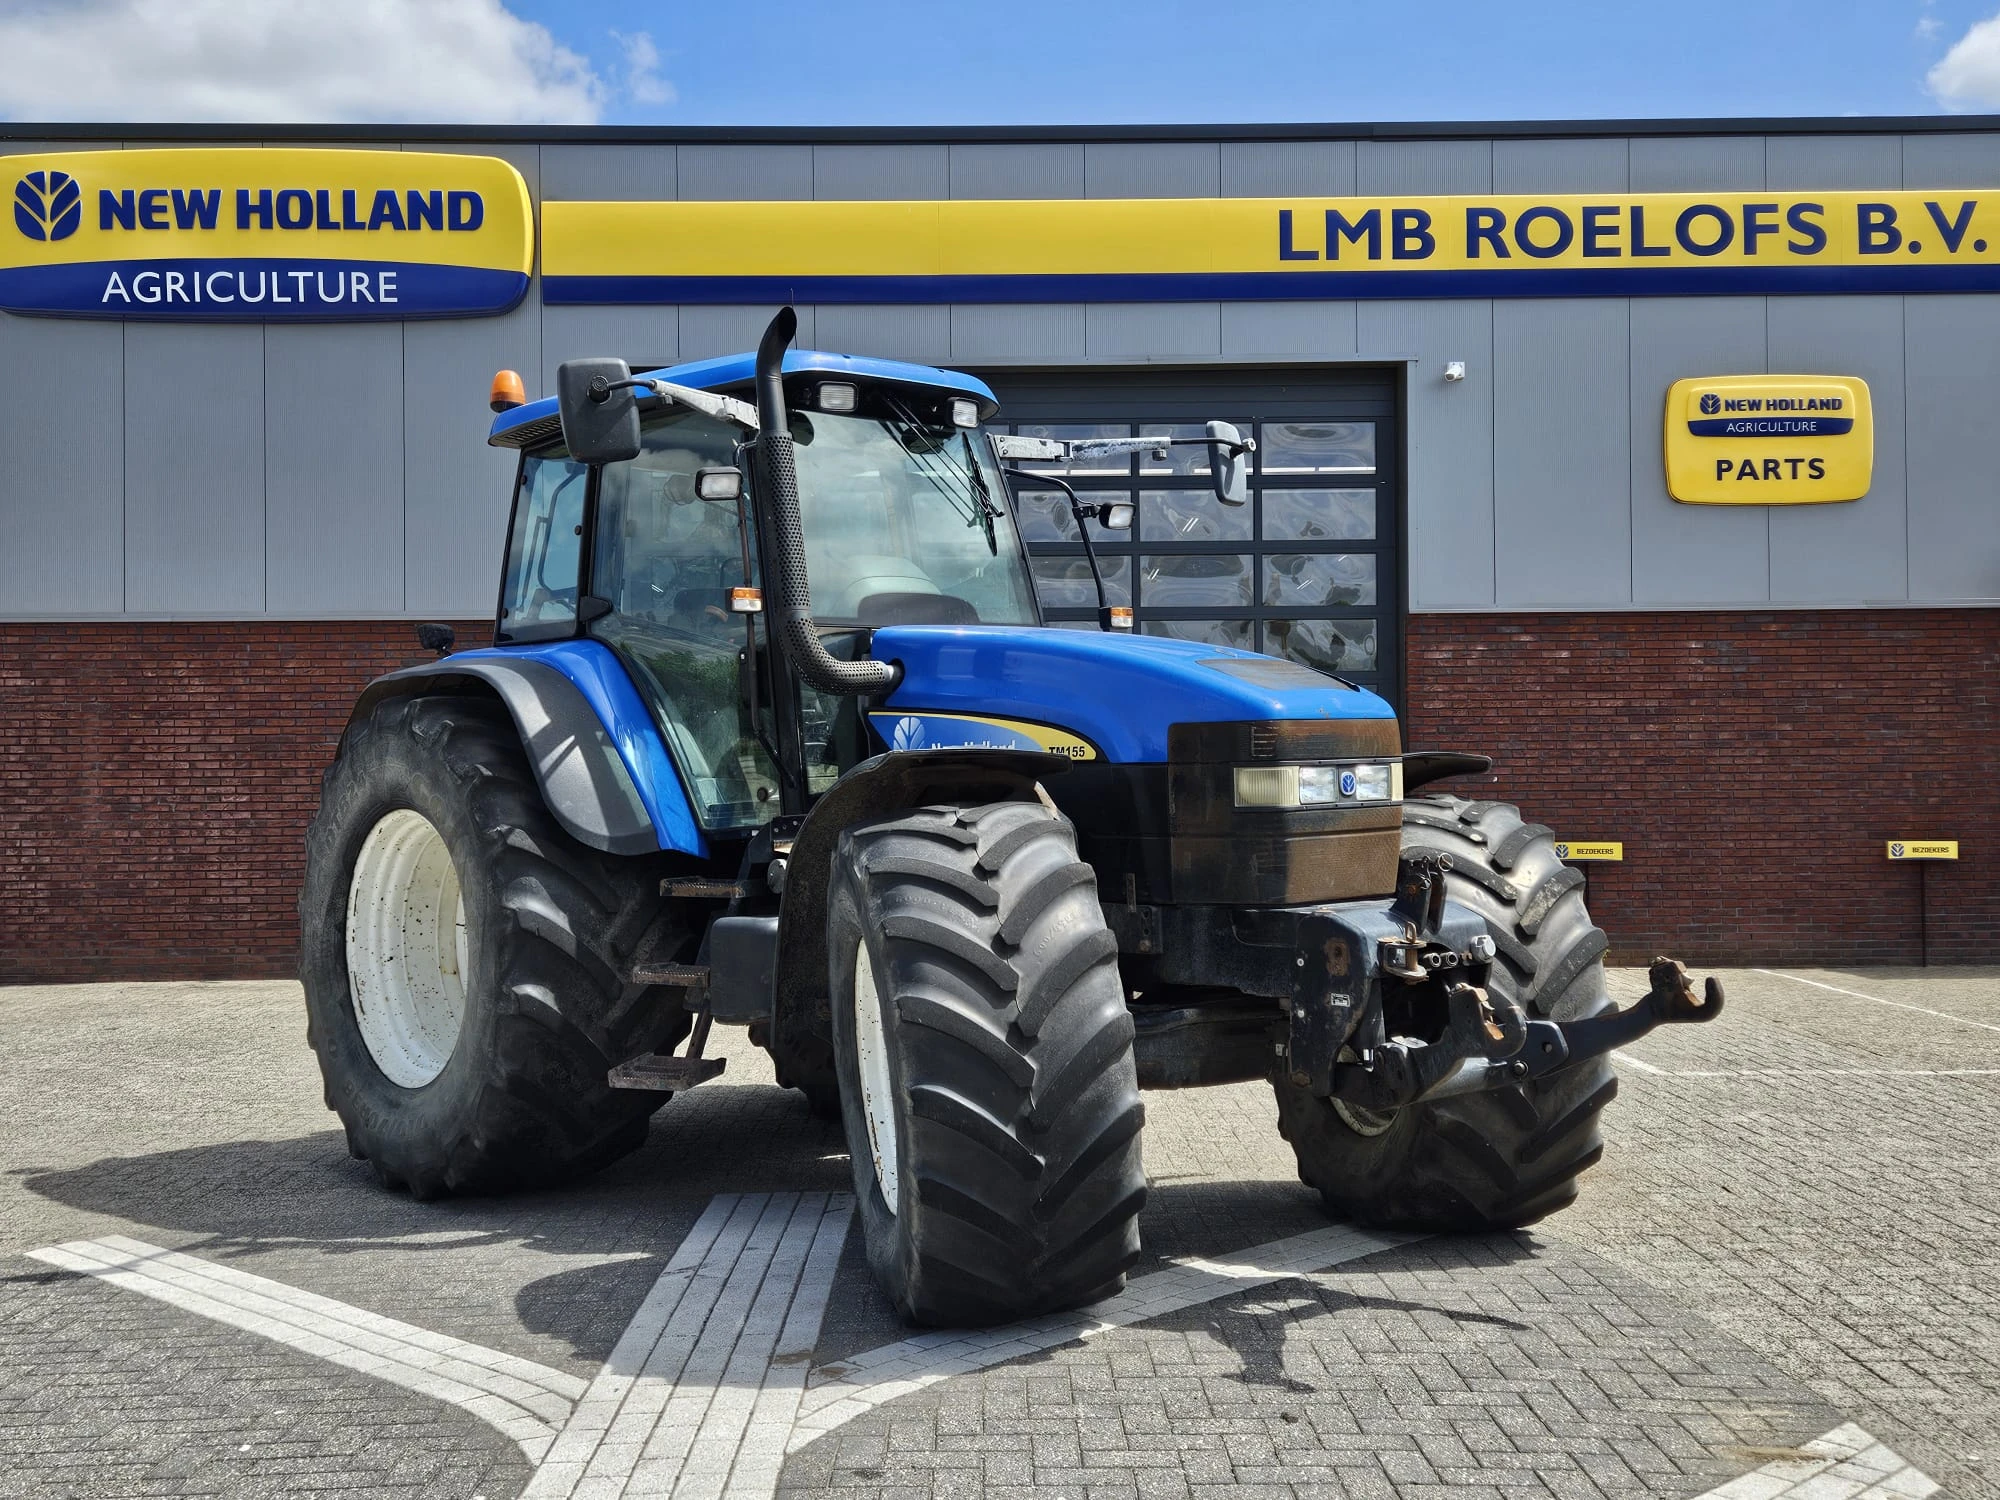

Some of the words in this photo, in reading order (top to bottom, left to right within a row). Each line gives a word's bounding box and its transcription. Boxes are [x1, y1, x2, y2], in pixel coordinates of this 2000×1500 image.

[99, 189, 222, 230] NEW
[235, 189, 484, 231] HOLLAND
[1279, 208, 1436, 261] LMB
[1465, 203, 1826, 258] ROELOFS
[1857, 201, 1988, 255] B.V.
[101, 270, 399, 304] AGRICULTURE
[1724, 398, 1762, 412] NEW
[1766, 397, 1843, 411] HOLLAND
[1726, 421, 1817, 433] AGRICULTURE
[1716, 457, 1826, 481] PARTS
